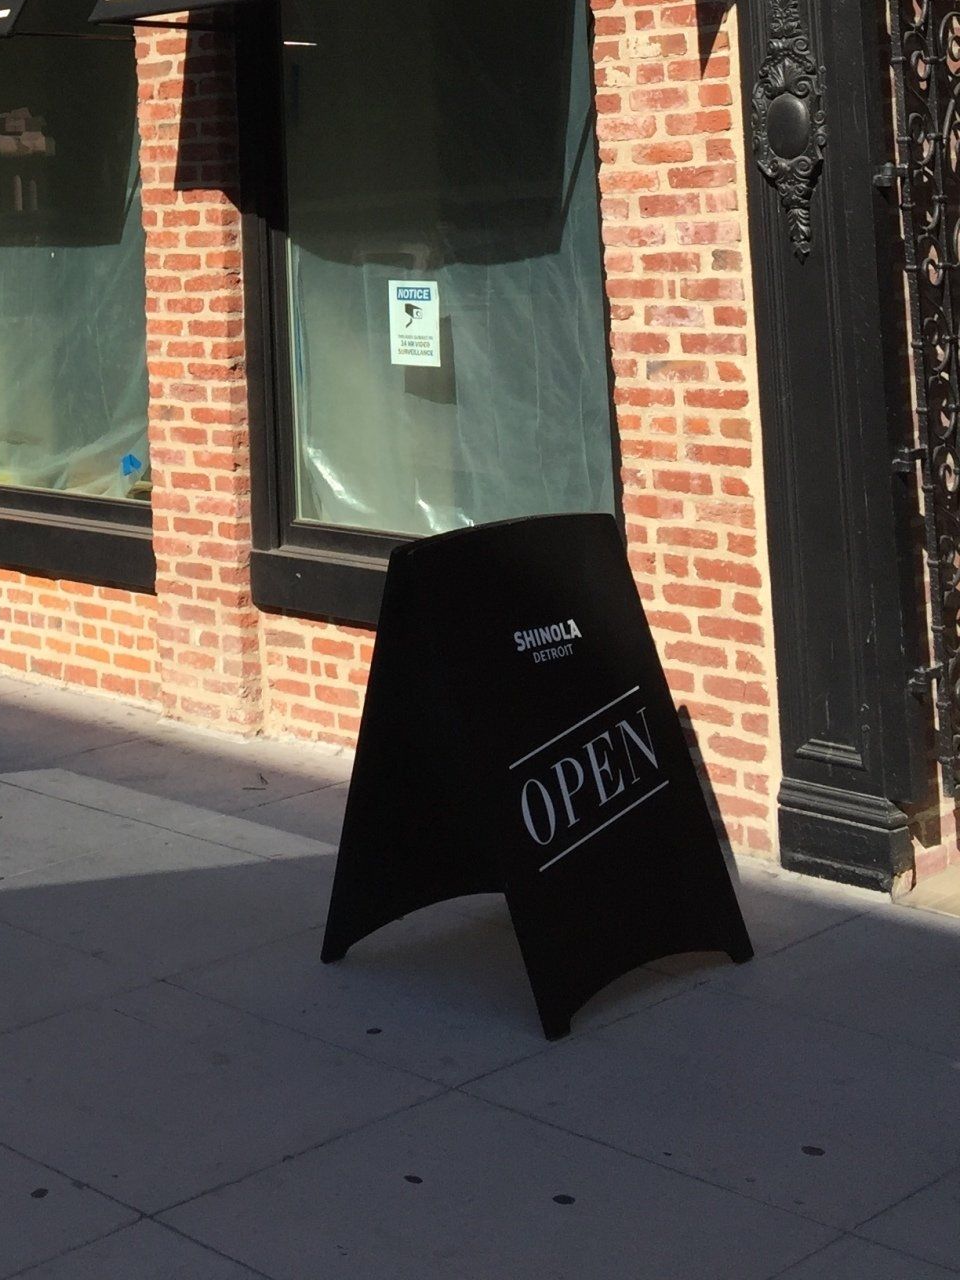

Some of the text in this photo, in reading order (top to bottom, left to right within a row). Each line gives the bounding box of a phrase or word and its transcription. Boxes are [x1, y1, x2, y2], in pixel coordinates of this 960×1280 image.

[397, 288, 429, 299] NOTICE
[513, 618, 583, 652] SHINOLA
[532, 642, 575, 664] DETROIT
[520, 706, 660, 846] OPEN
